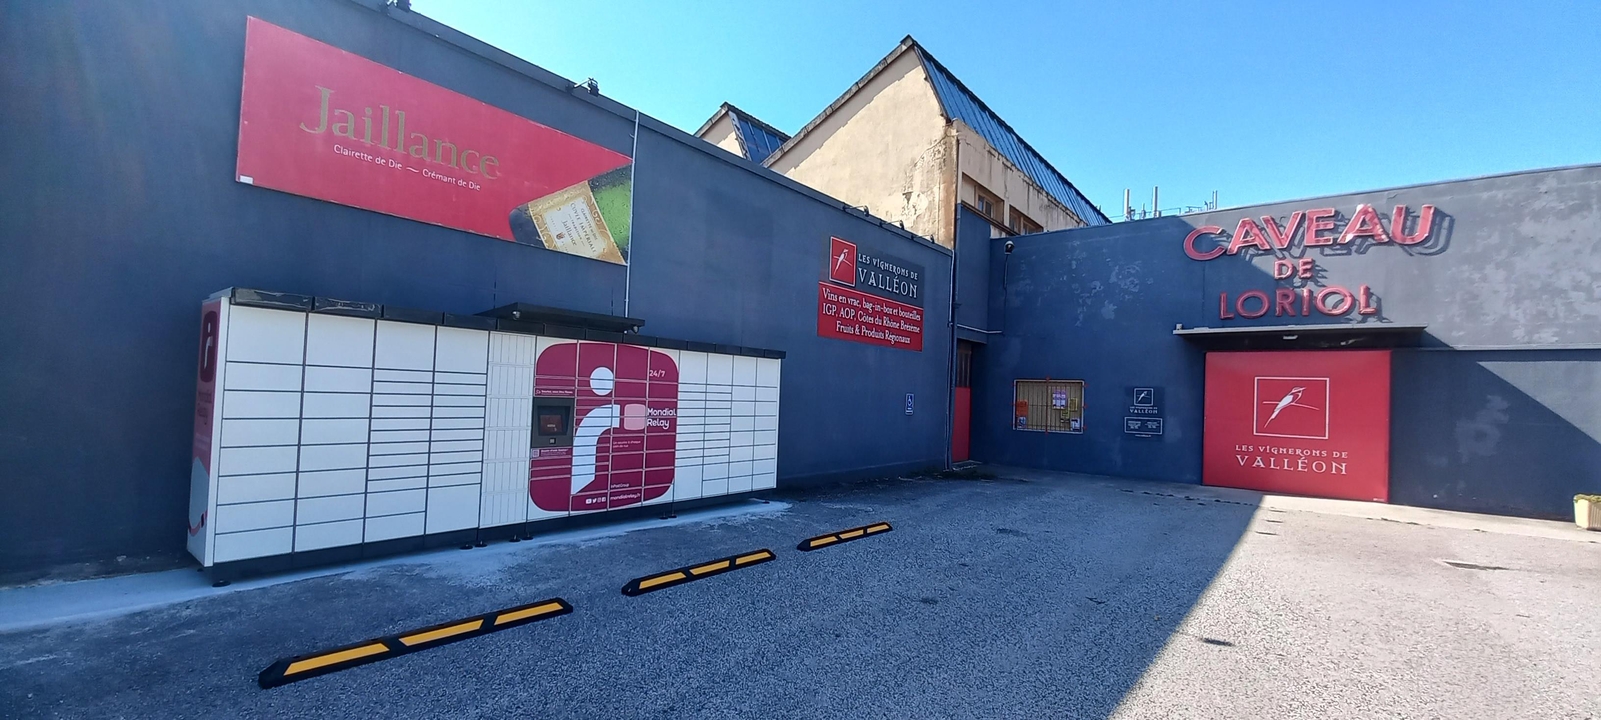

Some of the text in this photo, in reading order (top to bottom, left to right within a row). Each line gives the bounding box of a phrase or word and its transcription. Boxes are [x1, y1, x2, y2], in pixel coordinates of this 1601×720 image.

[300, 85, 501, 180] Jaillance
[334, 144, 481, 191] Clairette de Die Crémant de Die
[562, 219, 577, 246] Jaillance
[1183, 204, 1435, 260] CAVEAU
[858, 254, 918, 280] LES VIGNERONS DE
[1274, 258, 1314, 280] DE
[858, 268, 918, 298] VALLÉON
[822, 288, 921, 321] Vins en vrac, bag-in-box et bouteilles
[1219, 284, 1378, 320] LORIOL
[822, 303, 838, 317] IGP,
[839, 308, 856, 321] AOP,
[875, 315, 882, 326] du
[883, 316, 900, 329] Rhône
[836, 320, 911, 344] Fruits & Produits Régionaux
[649, 370, 666, 378] 24/7
[646, 418, 670, 430] Relay
[647, 408, 677, 416] Mondial
[1236, 454, 1348, 475] VALLÉON
[1258, 446, 1327, 457] VIGNERONS
